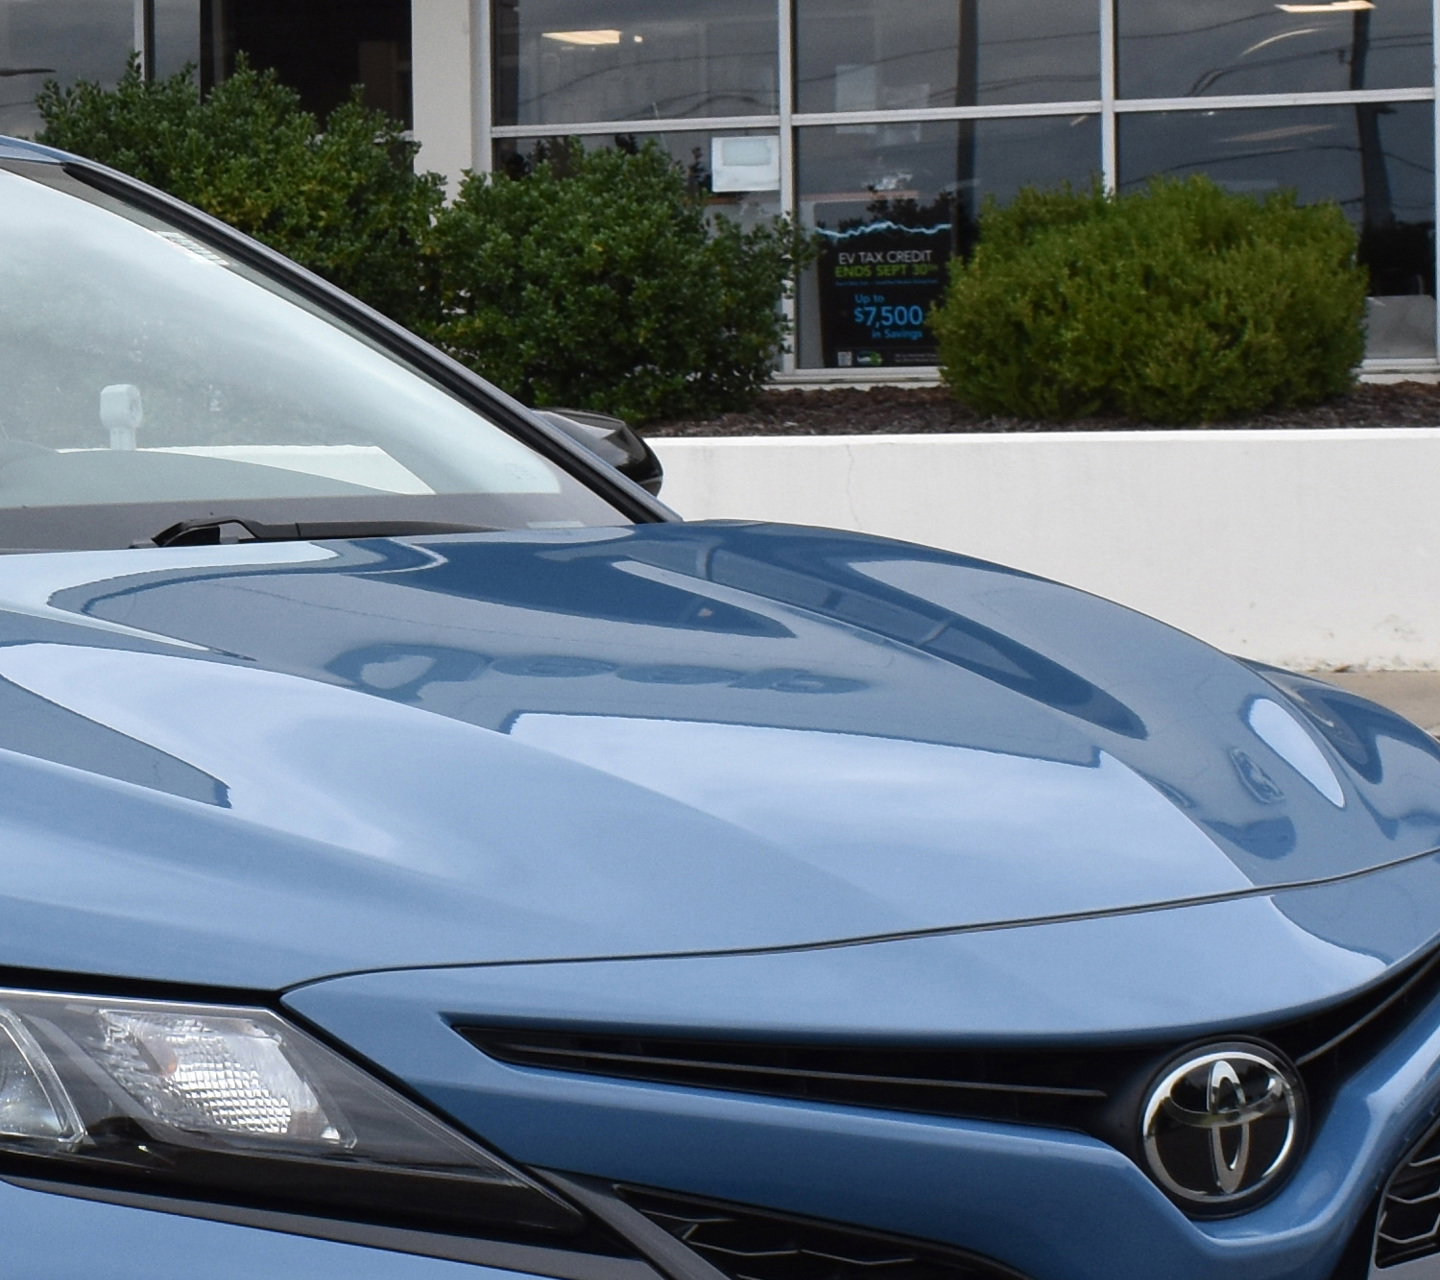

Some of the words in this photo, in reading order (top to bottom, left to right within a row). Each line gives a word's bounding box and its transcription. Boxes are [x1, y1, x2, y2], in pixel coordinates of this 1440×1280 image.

[838, 252, 855, 266] EV
[858, 251, 884, 264] TAX
[887, 249, 933, 264] CREDIT
[876, 264, 908, 277] SEPT
[853, 305, 924, 328] $7,500
